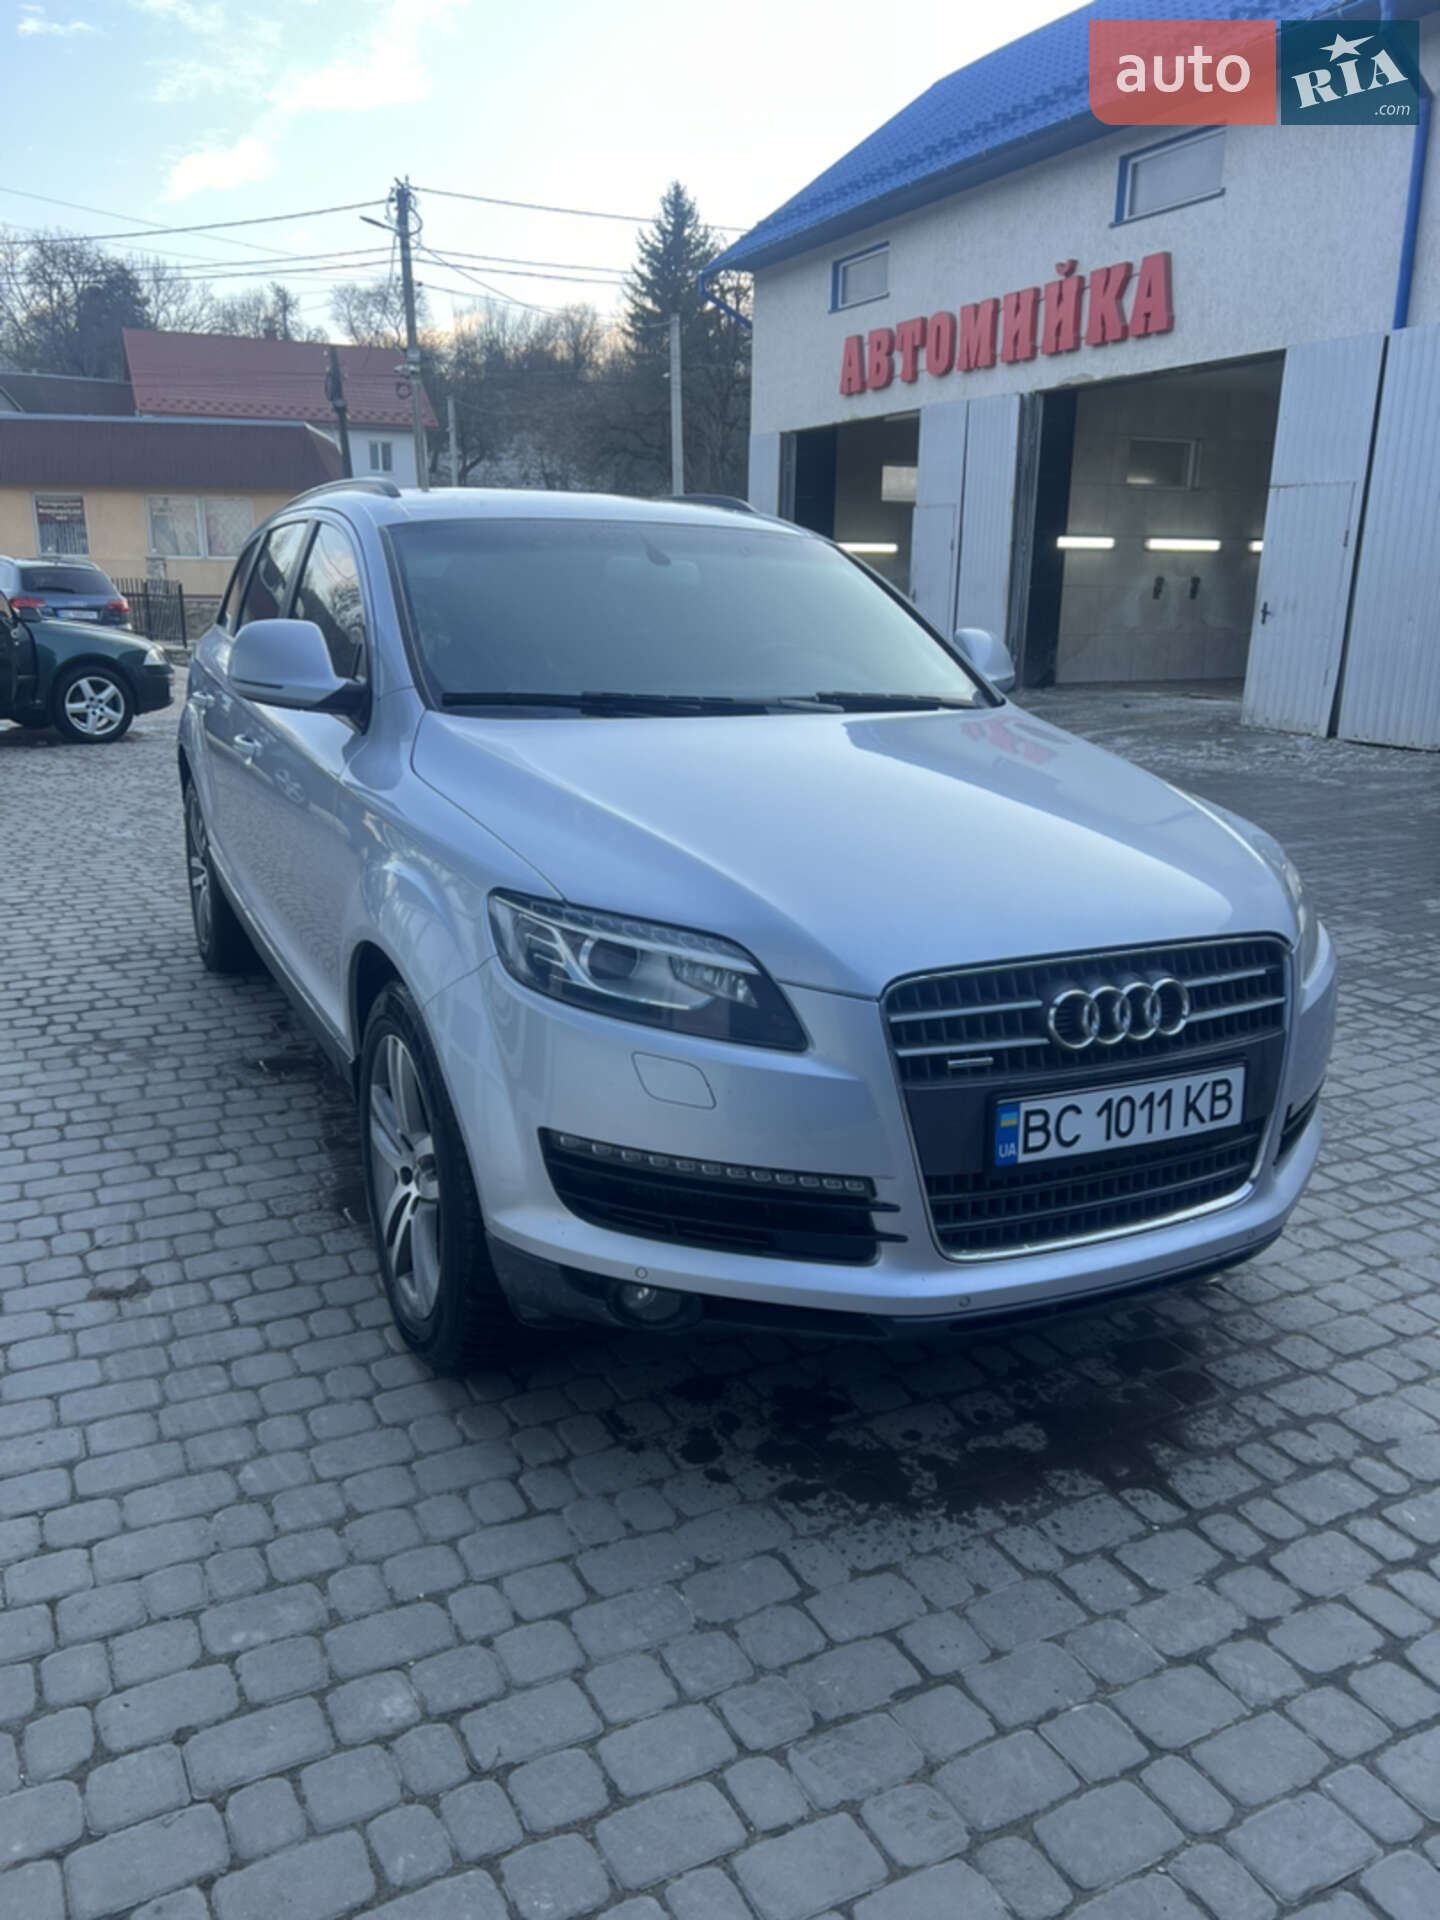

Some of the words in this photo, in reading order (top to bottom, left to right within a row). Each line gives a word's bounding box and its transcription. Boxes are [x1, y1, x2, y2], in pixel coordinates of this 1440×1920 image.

[839, 251, 1175, 396] АВТОМИЙКА
[998, 1143, 1017, 1158] UA
[1021, 1103, 1083, 1155] BC
[1096, 1088, 1174, 1141] 1011
[1183, 1078, 1233, 1128] KB
